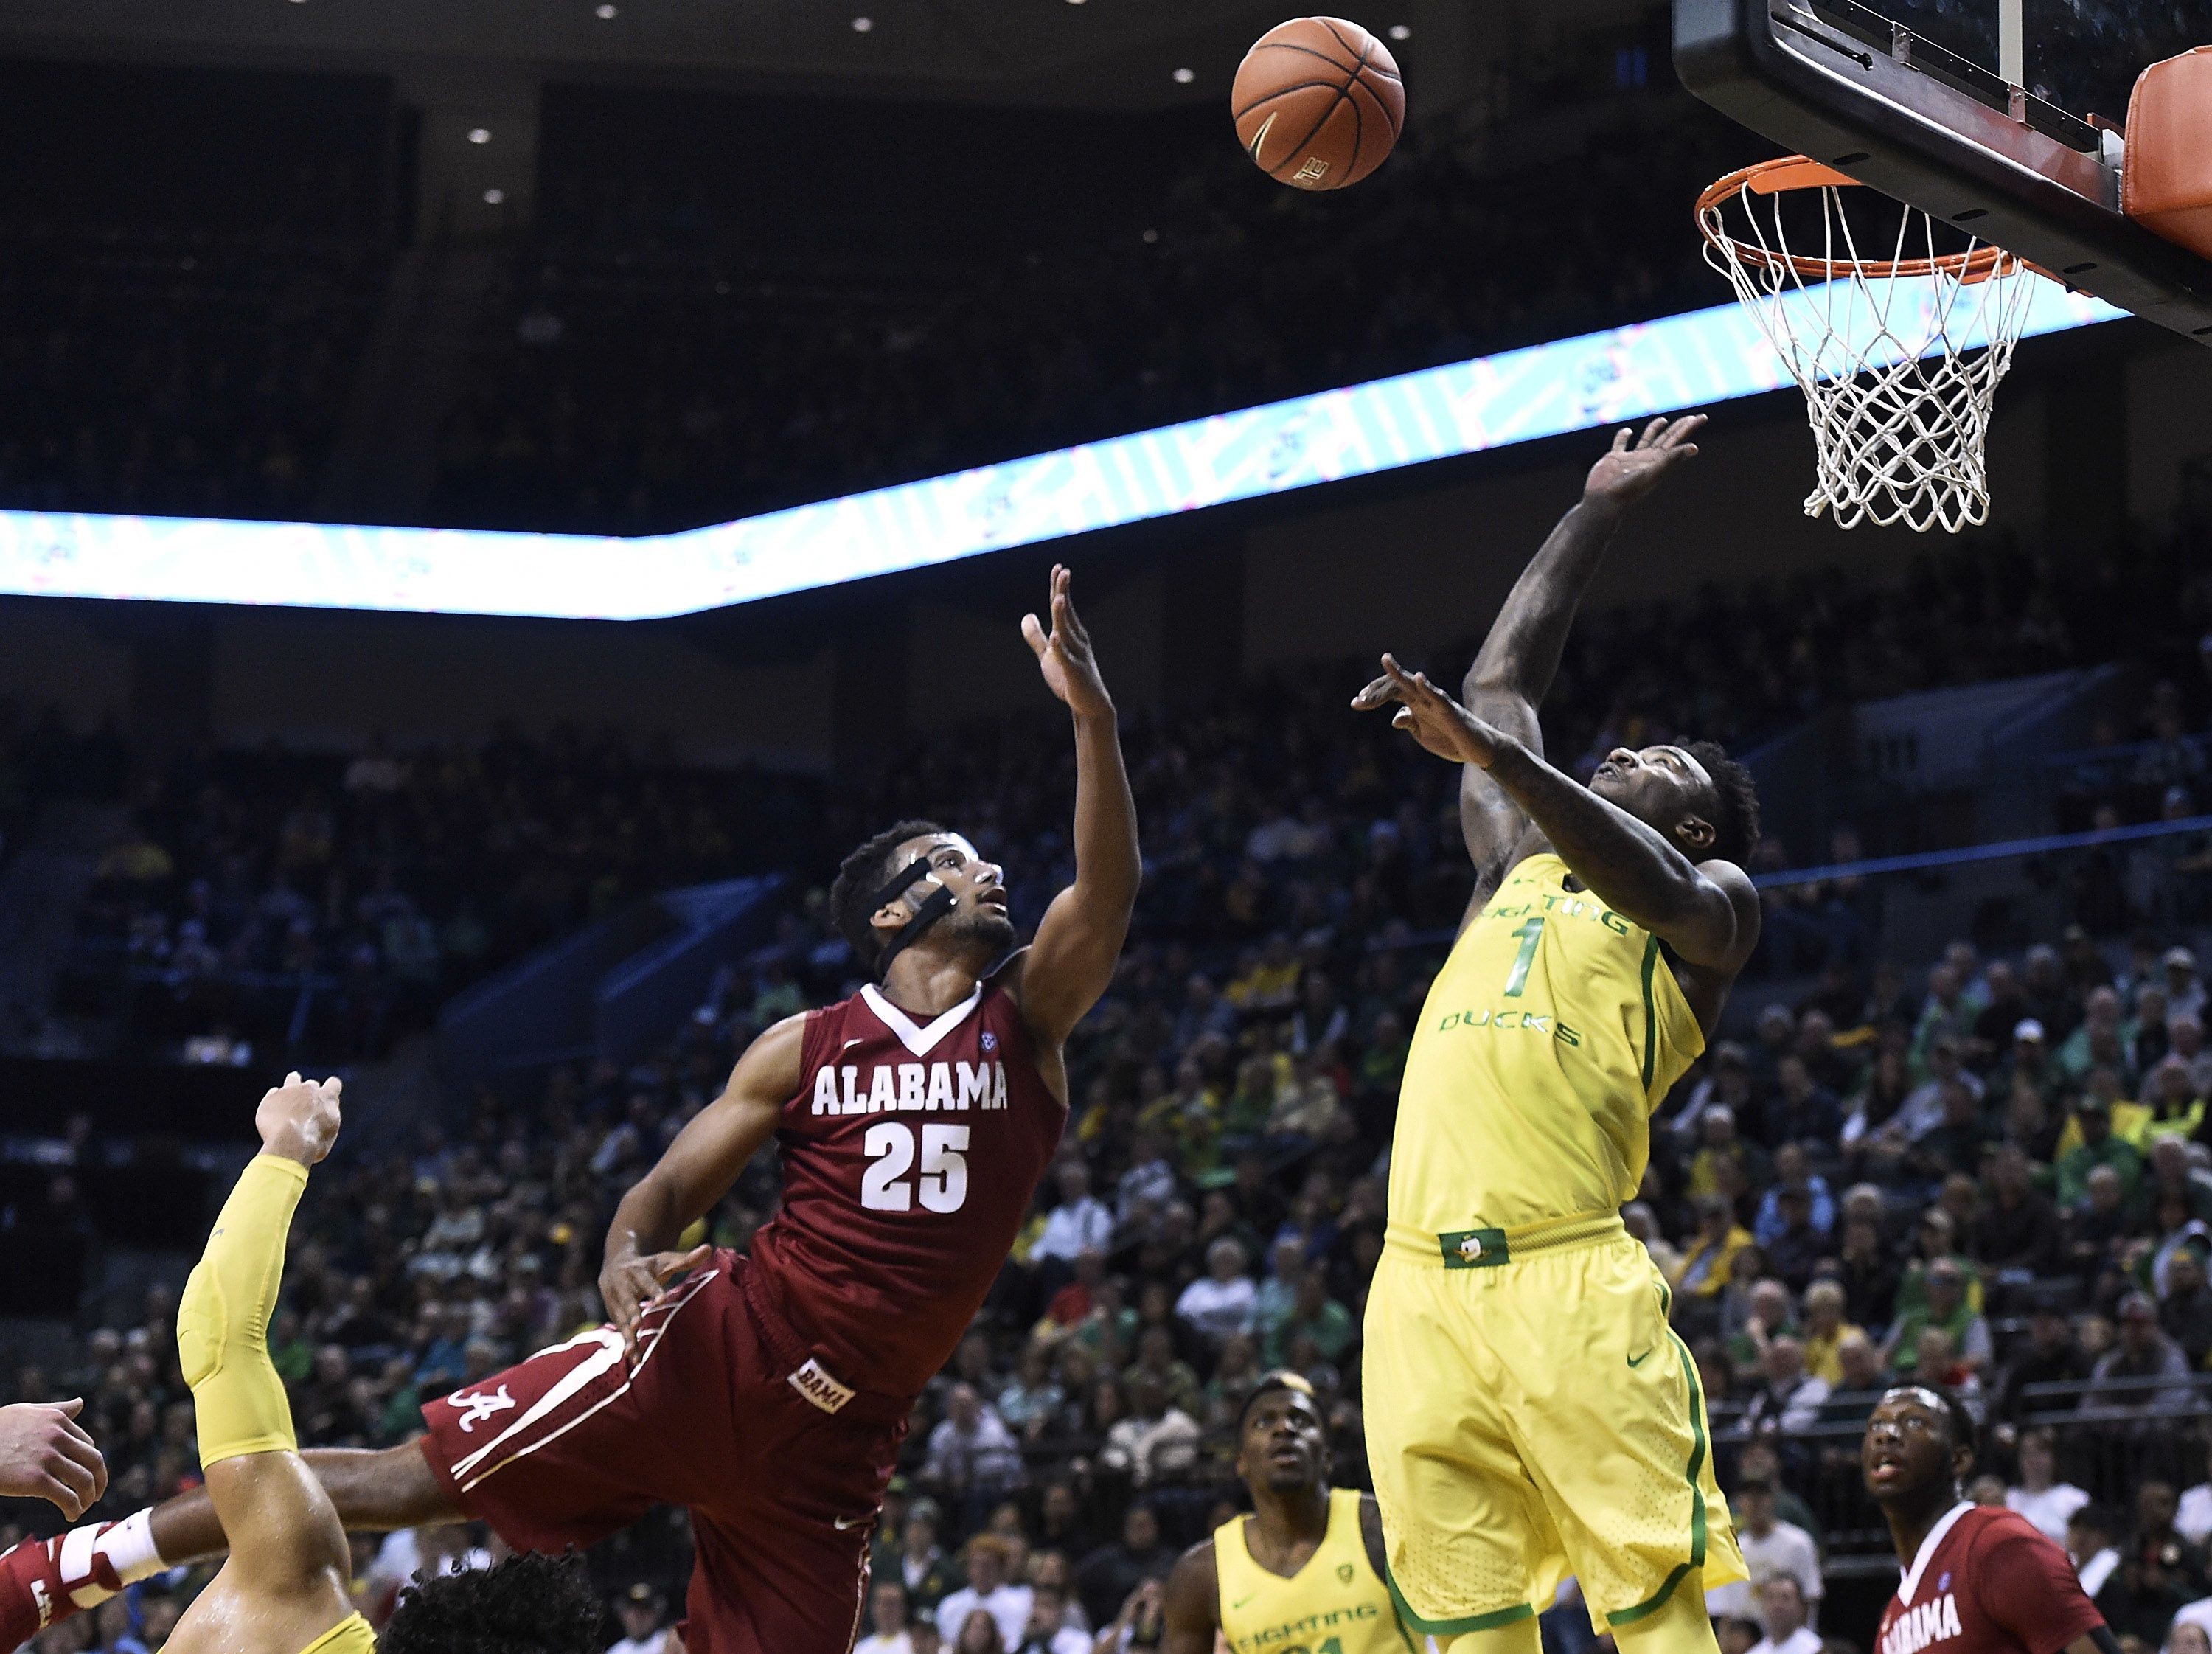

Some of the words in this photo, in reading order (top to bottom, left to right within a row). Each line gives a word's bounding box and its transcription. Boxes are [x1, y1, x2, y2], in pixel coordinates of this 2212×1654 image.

[1504, 917, 1545, 998] 1
[1439, 1010, 1581, 1047] DUCKS
[811, 1061, 1008, 1116] ALABAMA
[861, 1122, 970, 1214] 25
[798, 1369, 844, 1407] BAMA
[1239, 1603, 1377, 1647] FIGHTING
[1882, 1593, 1962, 1654] ABAMA
